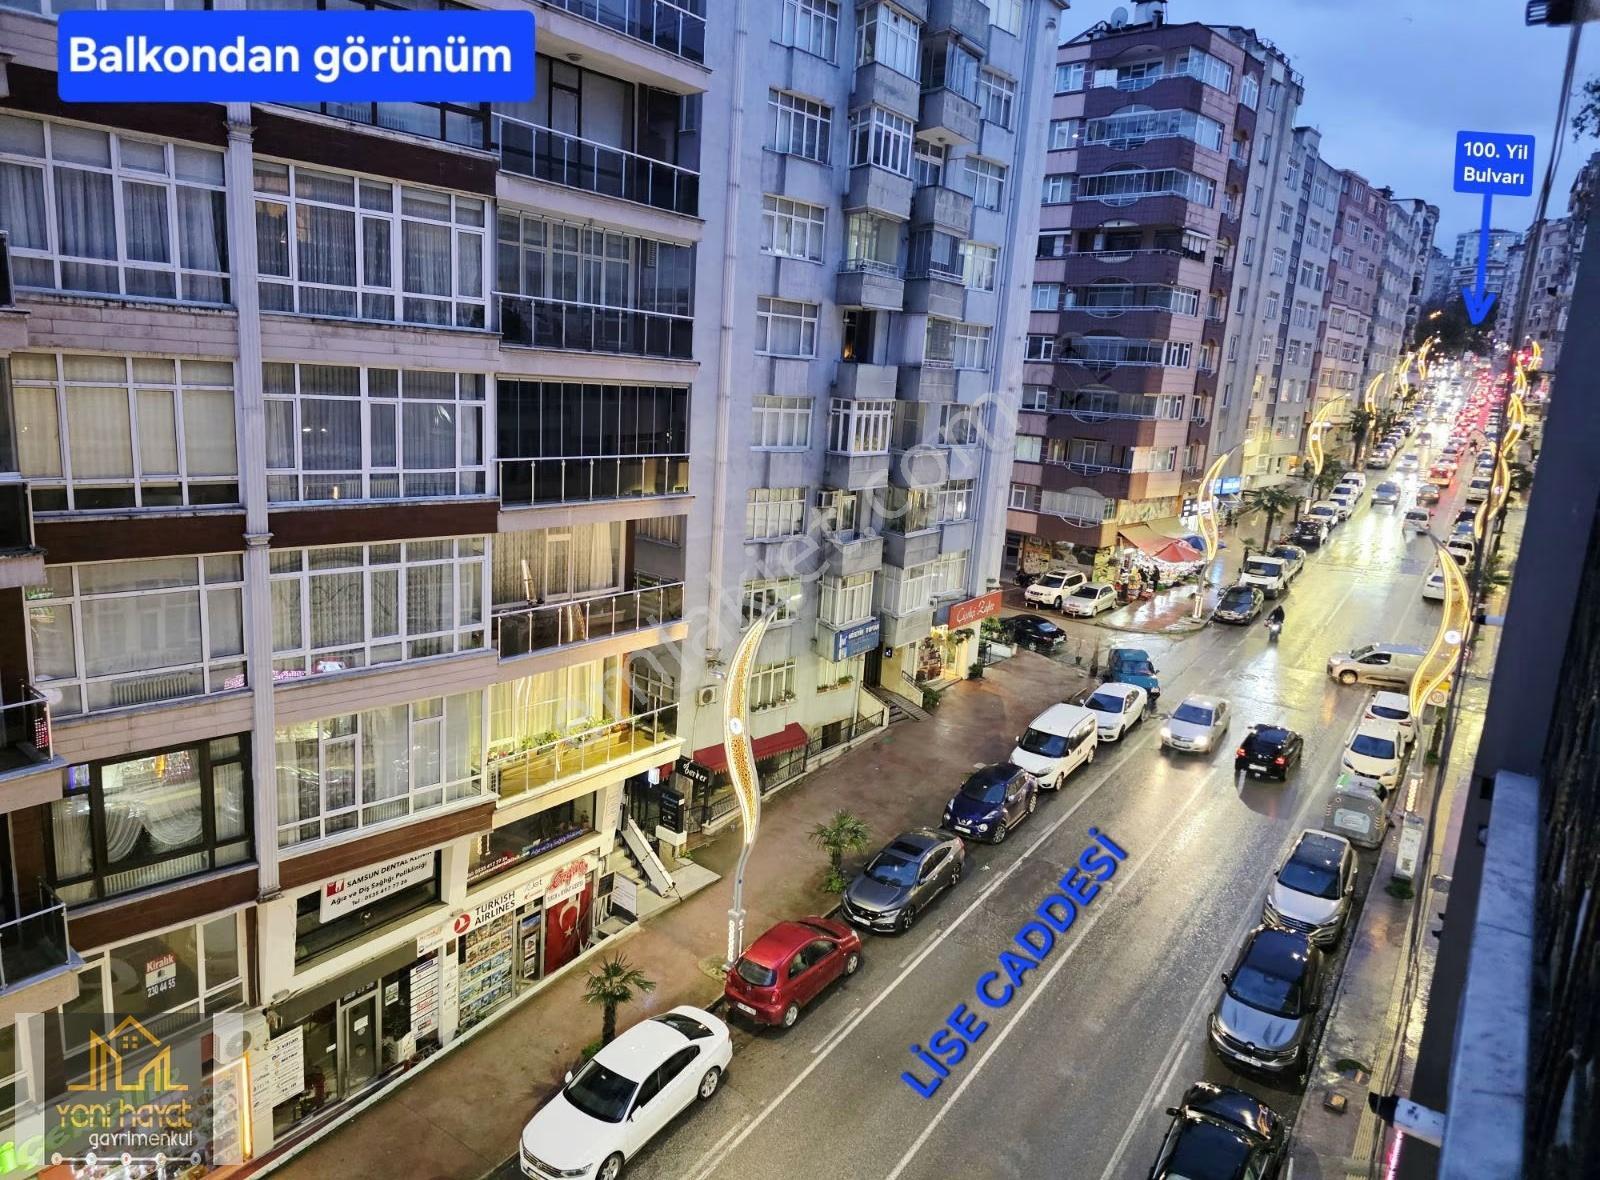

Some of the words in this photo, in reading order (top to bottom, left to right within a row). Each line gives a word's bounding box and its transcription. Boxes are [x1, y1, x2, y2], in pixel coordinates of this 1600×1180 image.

[346, 869, 380, 888] SAMSUN
[380, 859, 409, 874] DENTAL
[330, 895, 347, 906] Ağız
[348, 891, 358, 900] ve
[358, 885, 370, 895] Diş
[475, 890, 516, 916] TURKISH
[474, 900, 516, 926] AIRLINES
[146, 953, 174, 973] Kiralık
[147, 986, 158, 998] 230
[159, 982, 167, 992] 44
[168, 978, 176, 989] 55
